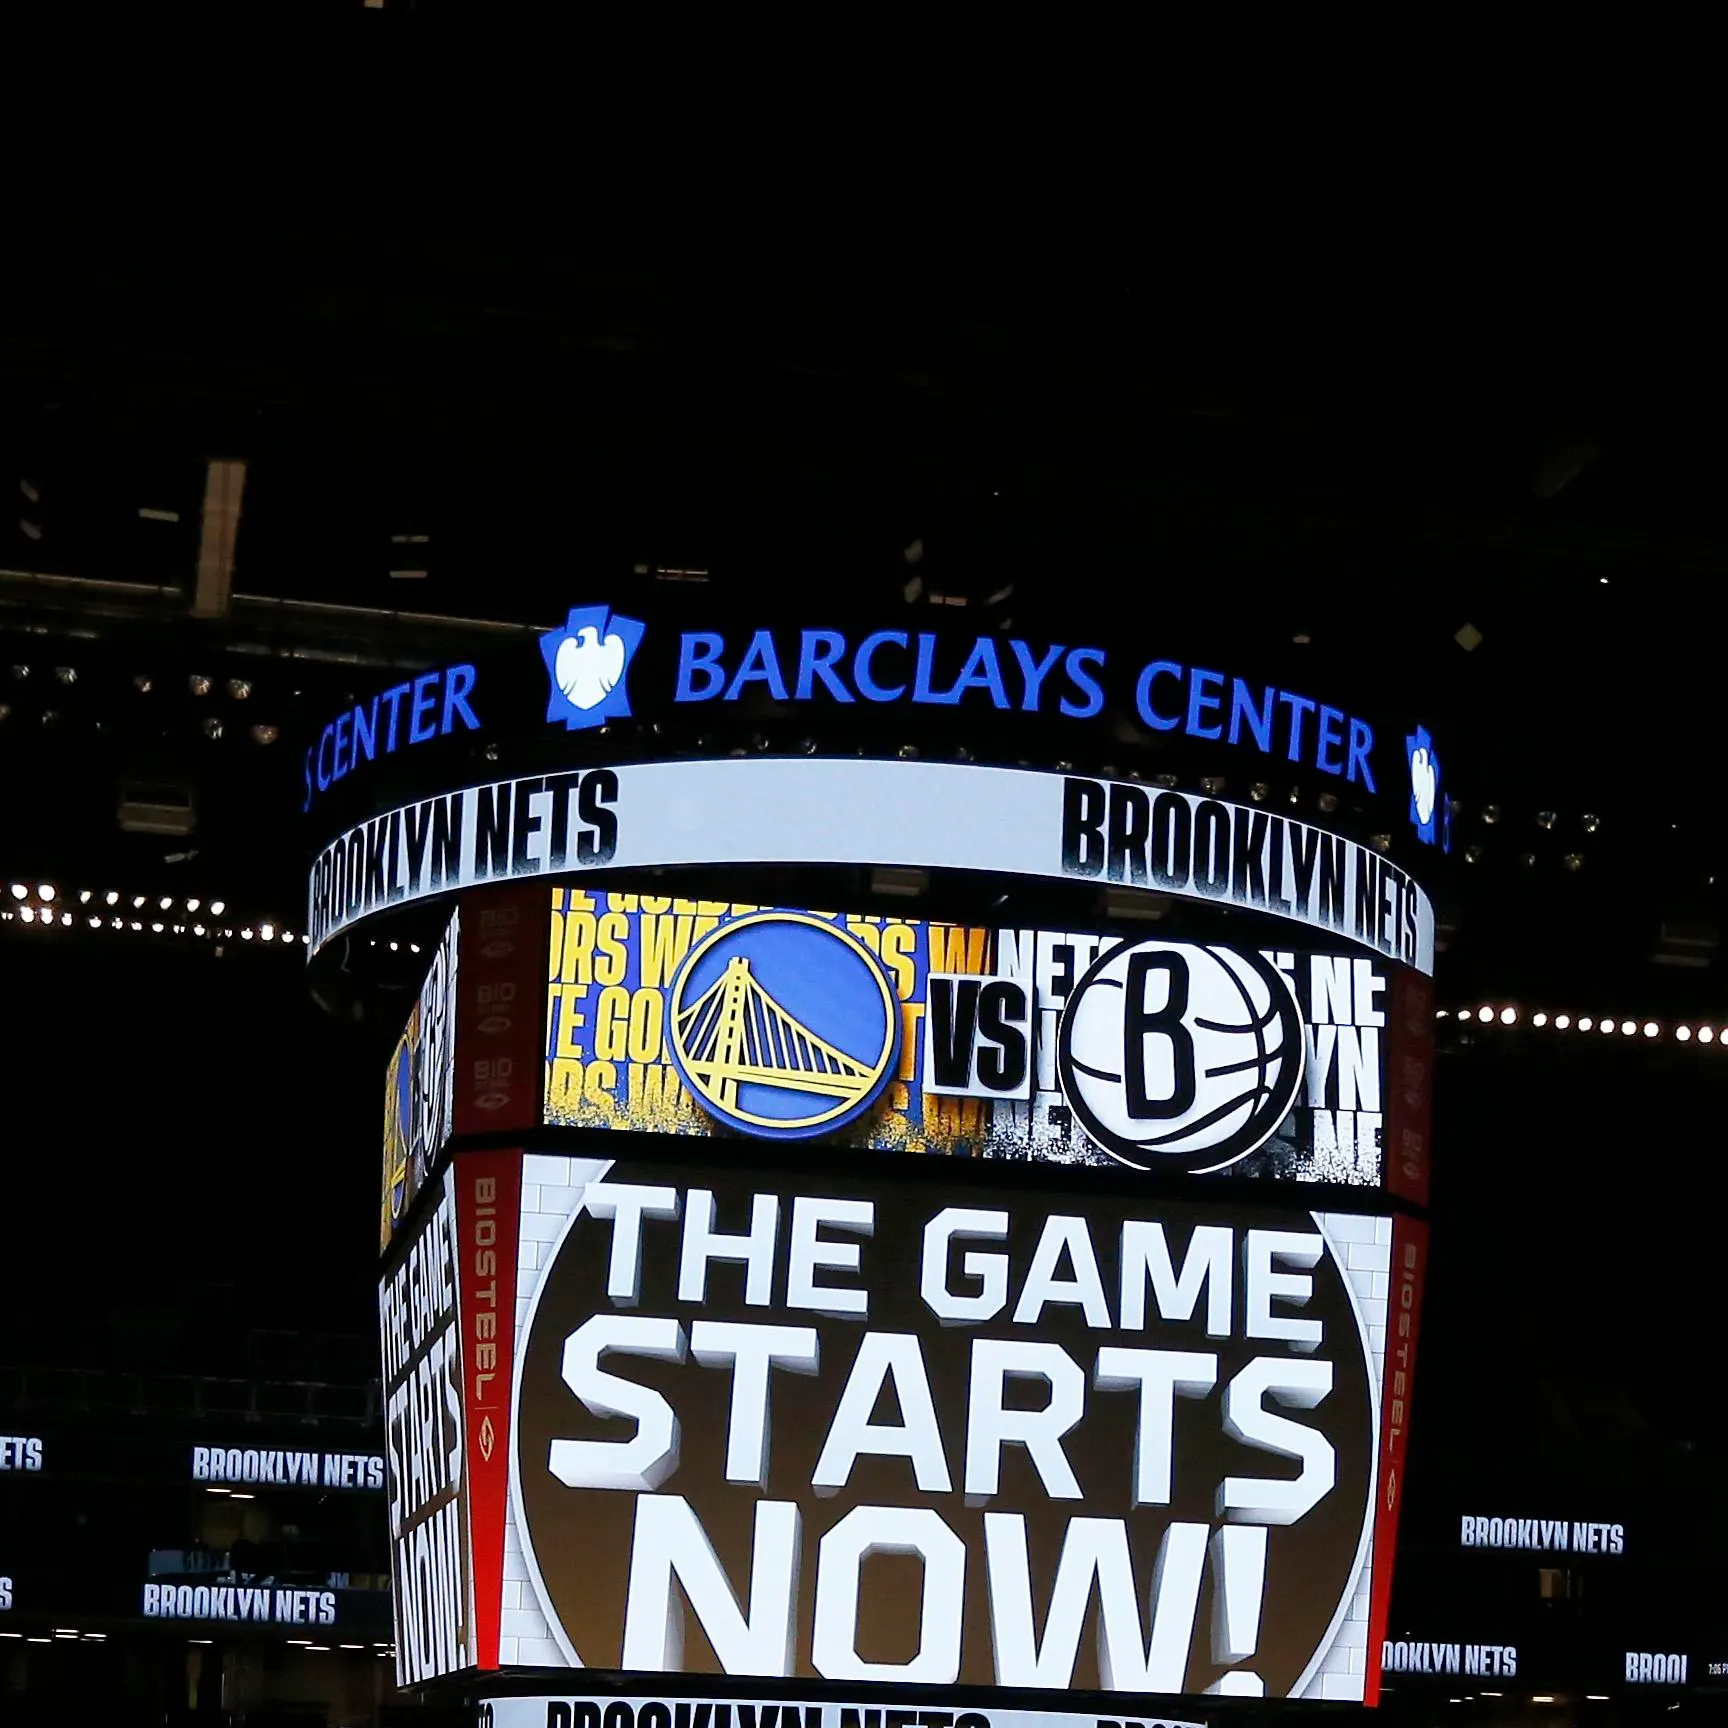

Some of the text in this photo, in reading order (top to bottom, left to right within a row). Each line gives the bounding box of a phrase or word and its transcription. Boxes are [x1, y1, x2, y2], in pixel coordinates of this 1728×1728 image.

[318, 664, 481, 791] CENTER
[674, 629, 1376, 794] BARCLAYS CENTER
[313, 769, 619, 942] BROOKLYN NETS
[1062, 776, 1418, 968] BROOKLYN NETS
[930, 979, 1027, 1091] VS
[1124, 950, 1195, 1119] B
[379, 1206, 454, 1384] THE GAME
[475, 1177, 497, 1402] BIOSTEEL
[583, 1181, 1322, 1349] THE GAME
[193, 1447, 383, 1490] BROOKLYN NETS
[389, 1321, 463, 1541] STARTS
[547, 1313, 1337, 1524] STARTS
[144, 1583, 336, 1624] BROOKLYN NETS
[396, 1497, 467, 1688] NOW!
[620, 1493, 1268, 1696] NOW!
[1461, 1516, 1623, 1553] BROOKLYN NETS
[1381, 1642, 1517, 1677] OOKLYN NETS
